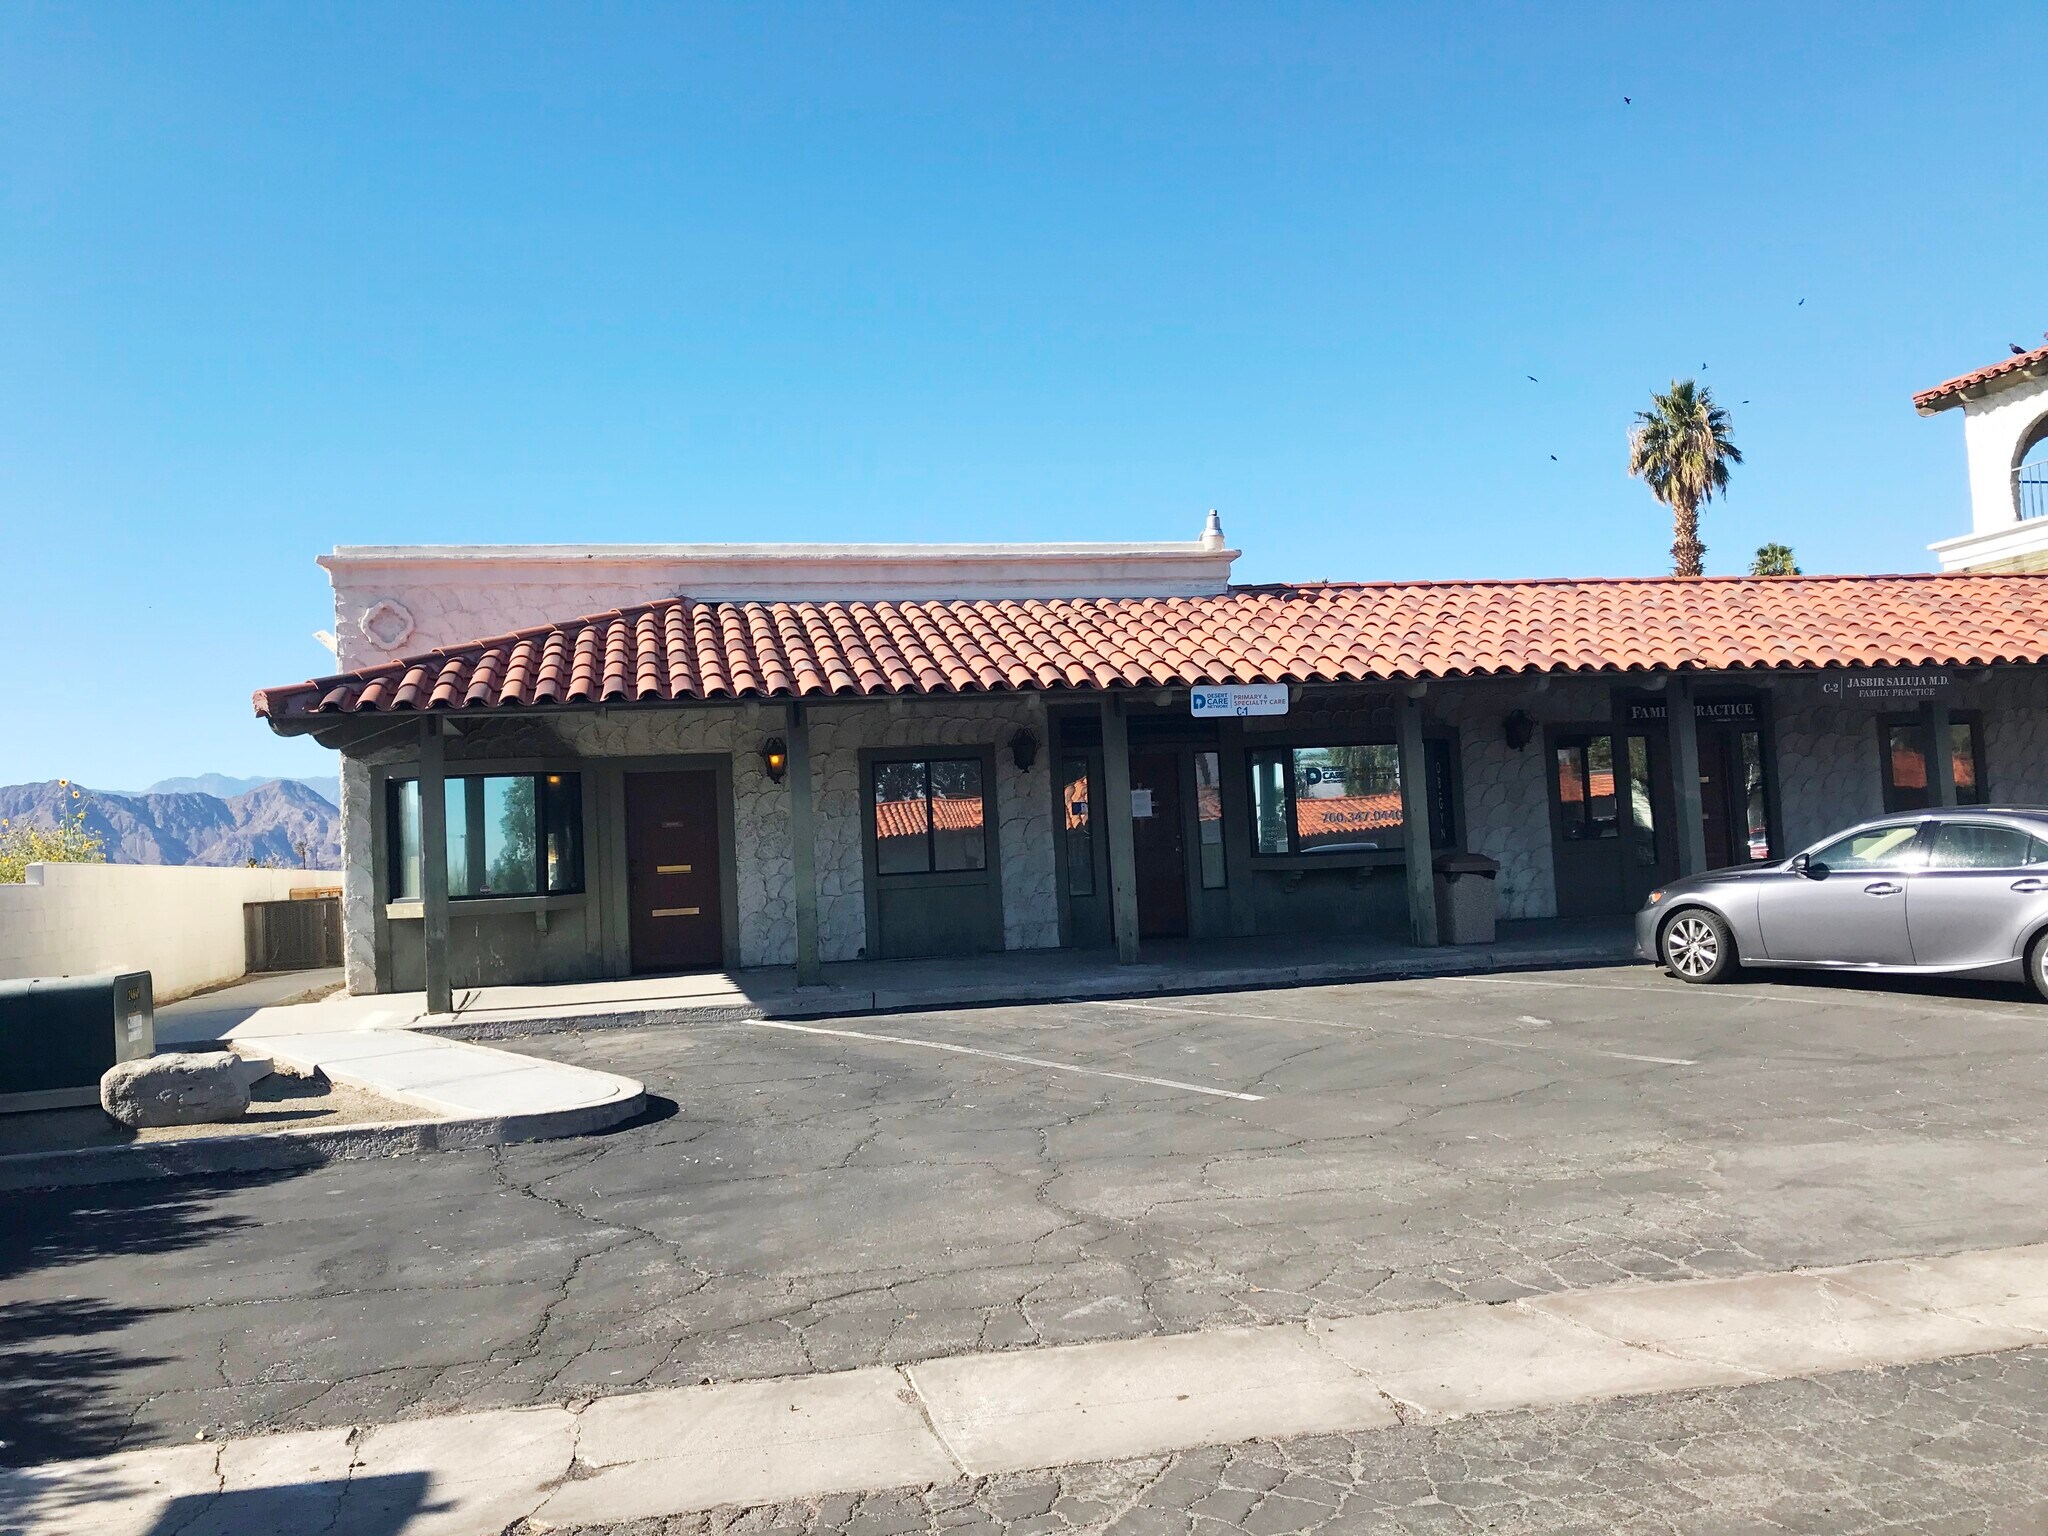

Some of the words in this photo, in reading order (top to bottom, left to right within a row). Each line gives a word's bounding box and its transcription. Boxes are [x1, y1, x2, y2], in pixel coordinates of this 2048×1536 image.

[1847, 678, 1884, 688] JASBIR
[1886, 676, 1926, 687] SALUJA
[1929, 675, 1949, 686] M.D.
[1823, 683, 1839, 693] C-2
[1859, 689, 1890, 697] FAMILY
[1892, 687, 1936, 697] PRACTICE
[1236, 706, 1248, 716] C-1
[1631, 706, 1668, 719] FAMI
[1694, 703, 1754, 717] RACTICE
